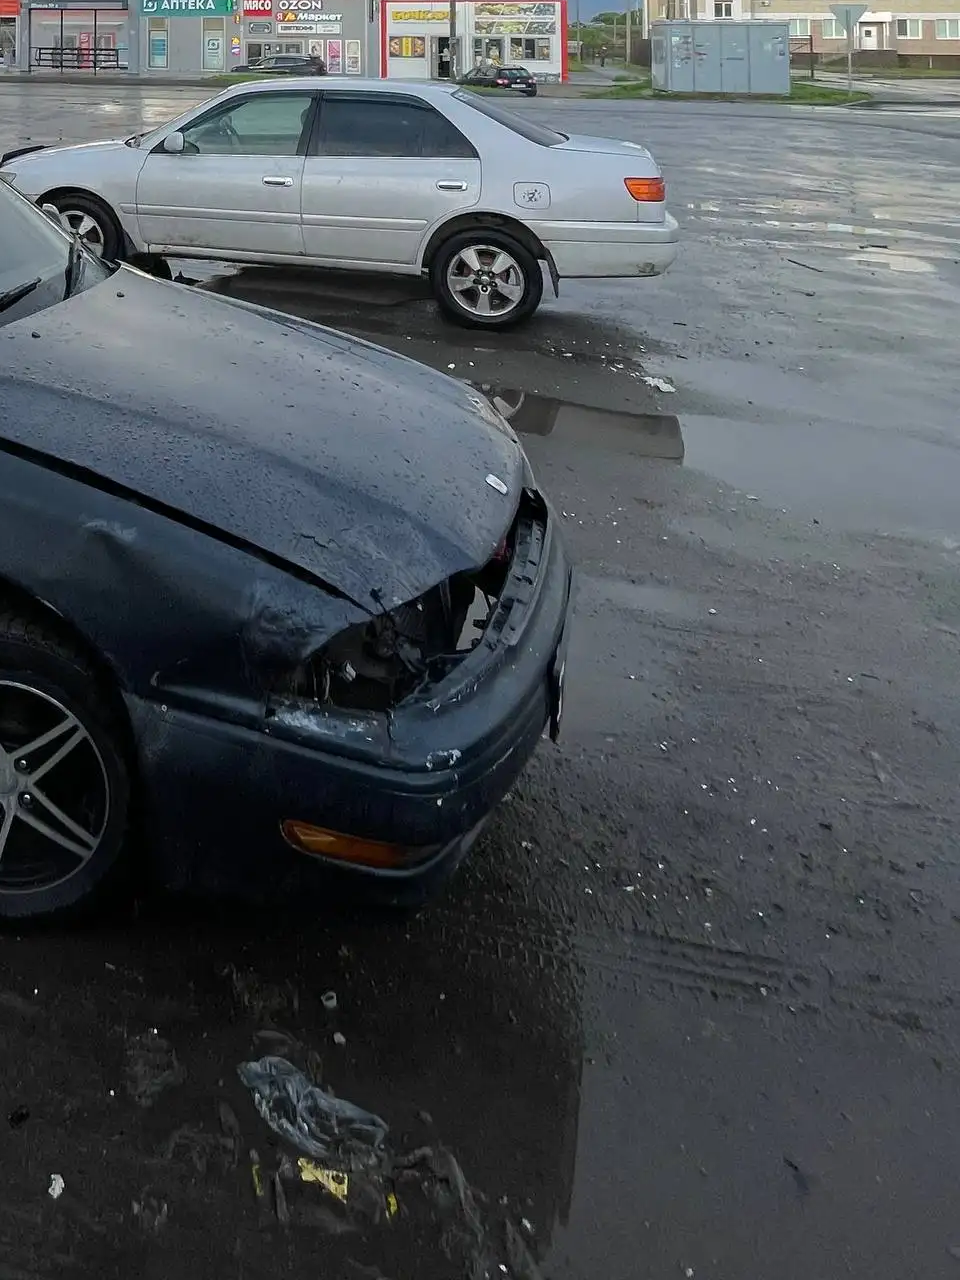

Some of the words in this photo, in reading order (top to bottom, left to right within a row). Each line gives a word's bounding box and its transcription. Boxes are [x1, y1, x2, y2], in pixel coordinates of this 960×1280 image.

[160, 0, 216, 10] АПТЕКА
[243, 0, 272, 11] МЯСО
[279, 0, 323, 10] OZON
[296, 12, 343, 22] Маркет
